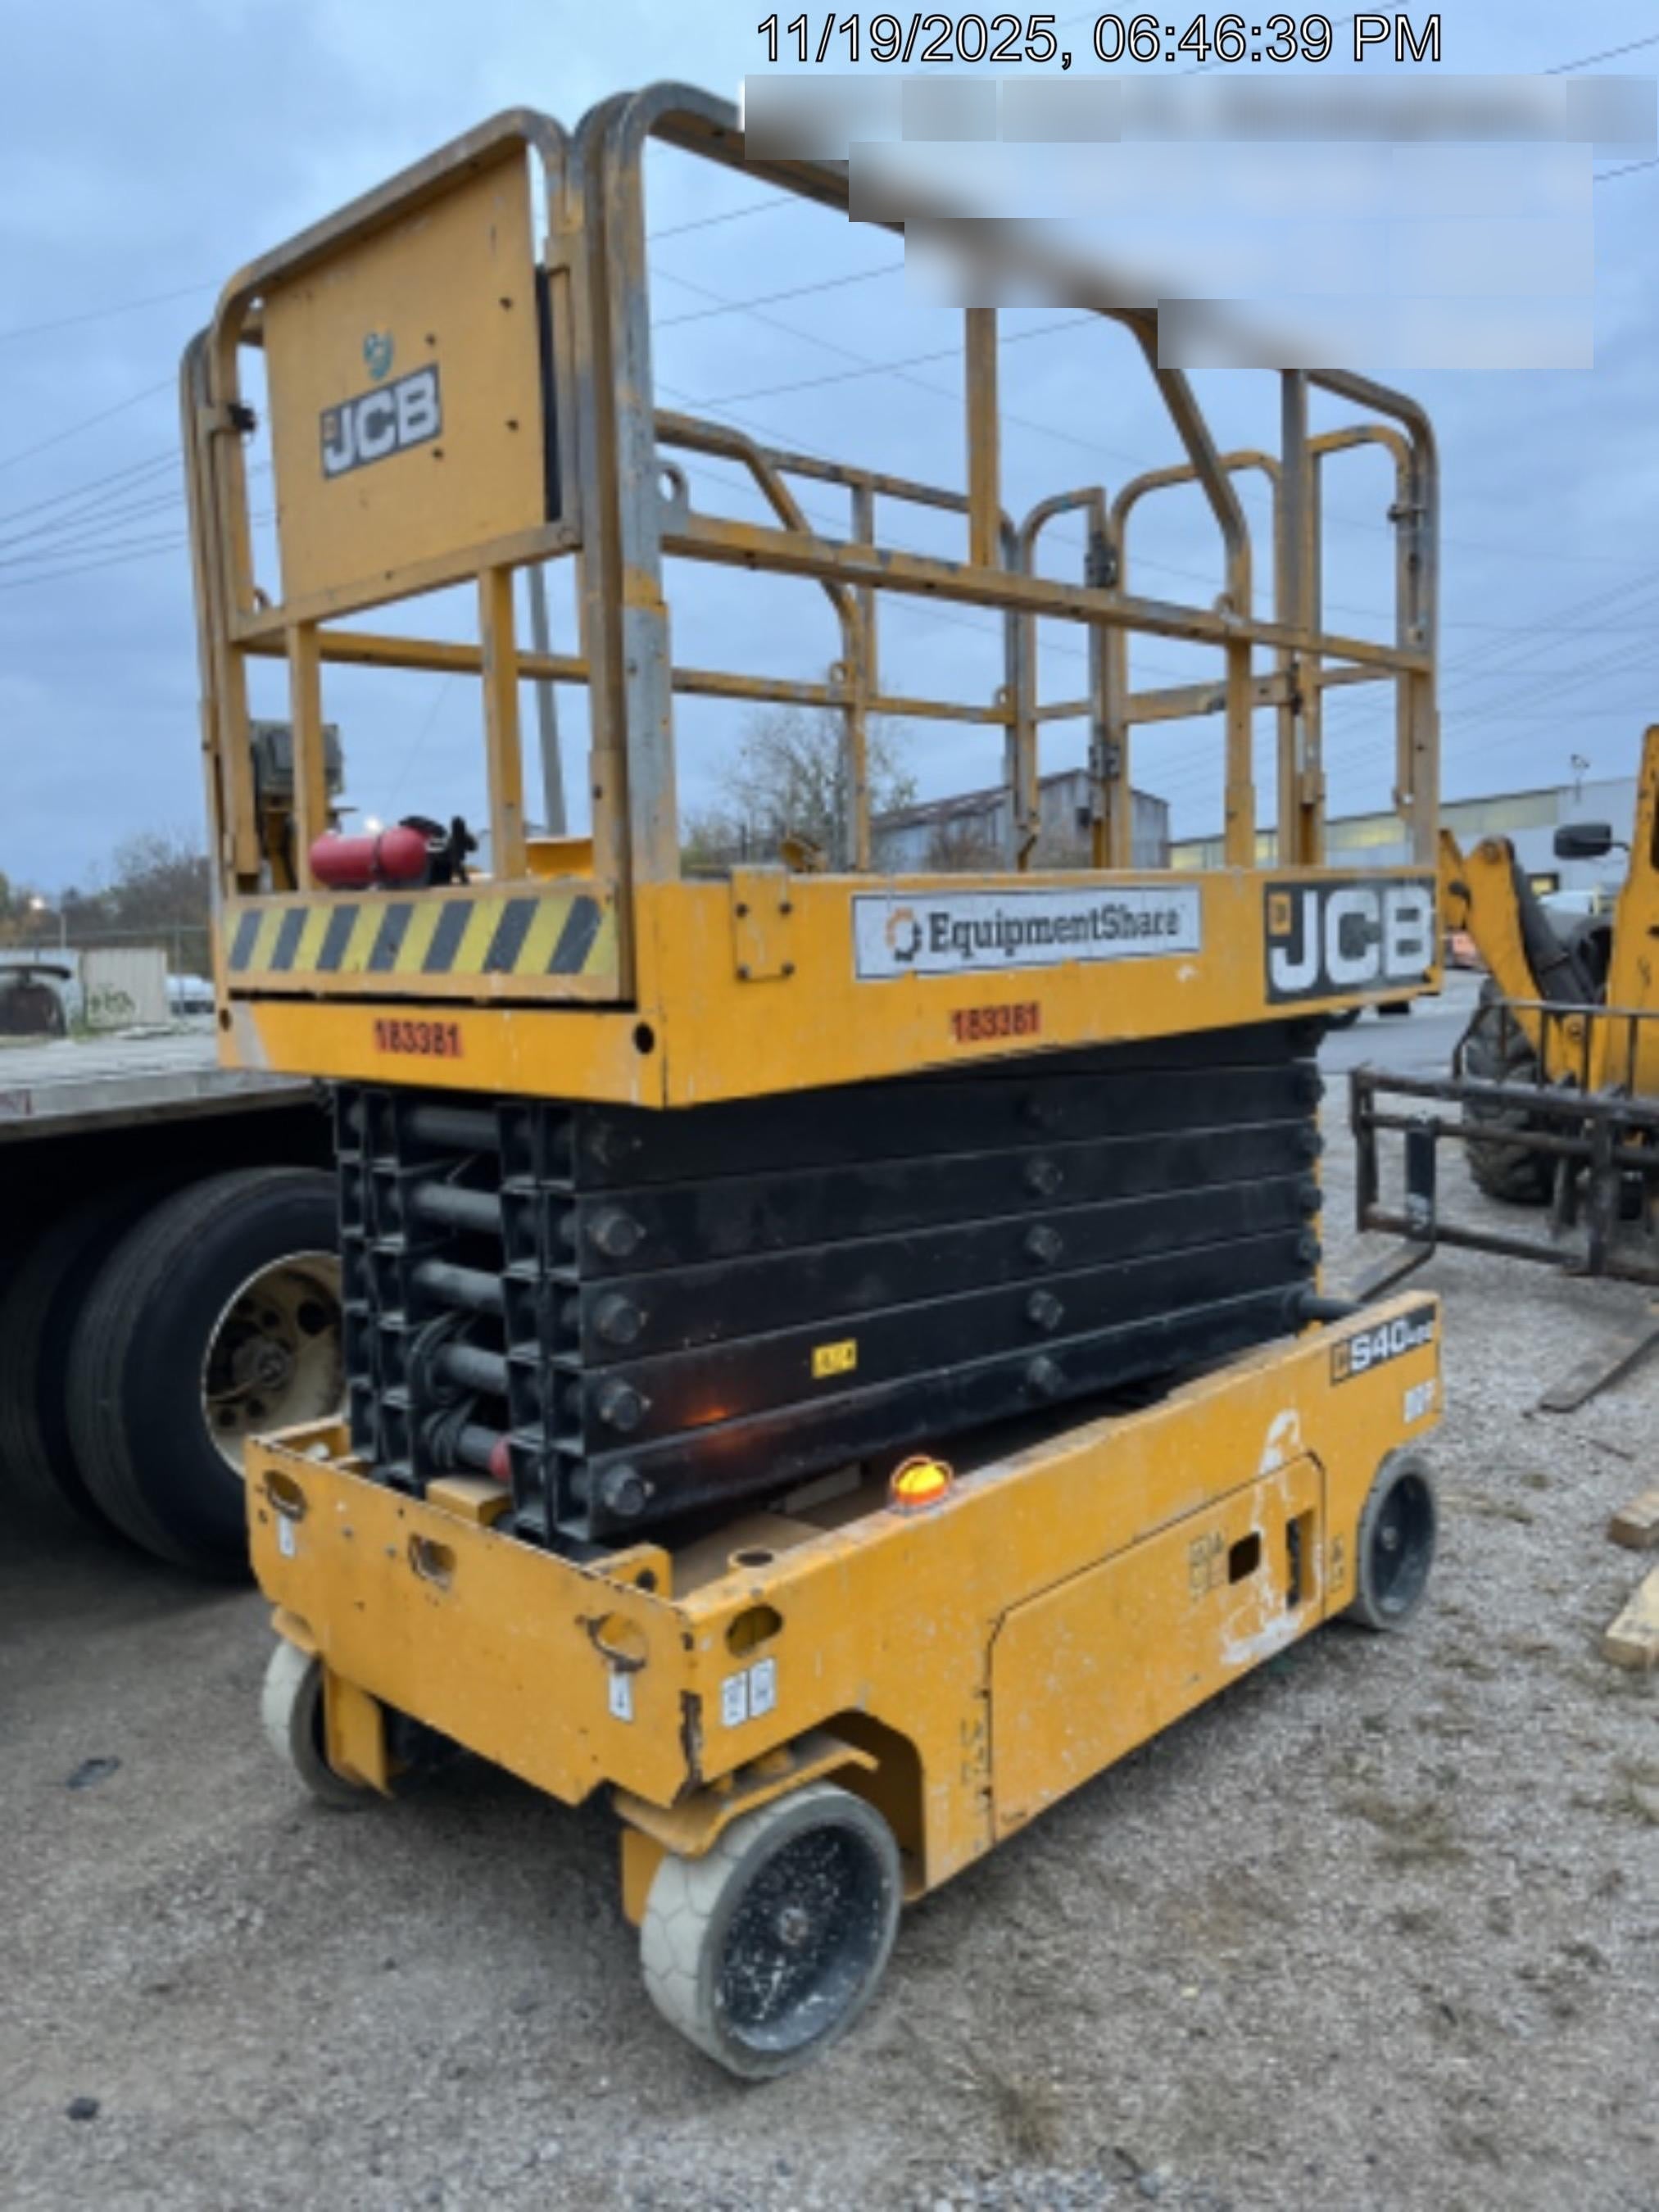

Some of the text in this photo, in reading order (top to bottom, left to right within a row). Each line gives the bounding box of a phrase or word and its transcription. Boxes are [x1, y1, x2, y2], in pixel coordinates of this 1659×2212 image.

[323, 369, 439, 473] JCB
[927, 904, 1180, 958] EquipmentShare
[1271, 886, 1432, 992] JCB
[375, 1018, 460, 1058] 183381
